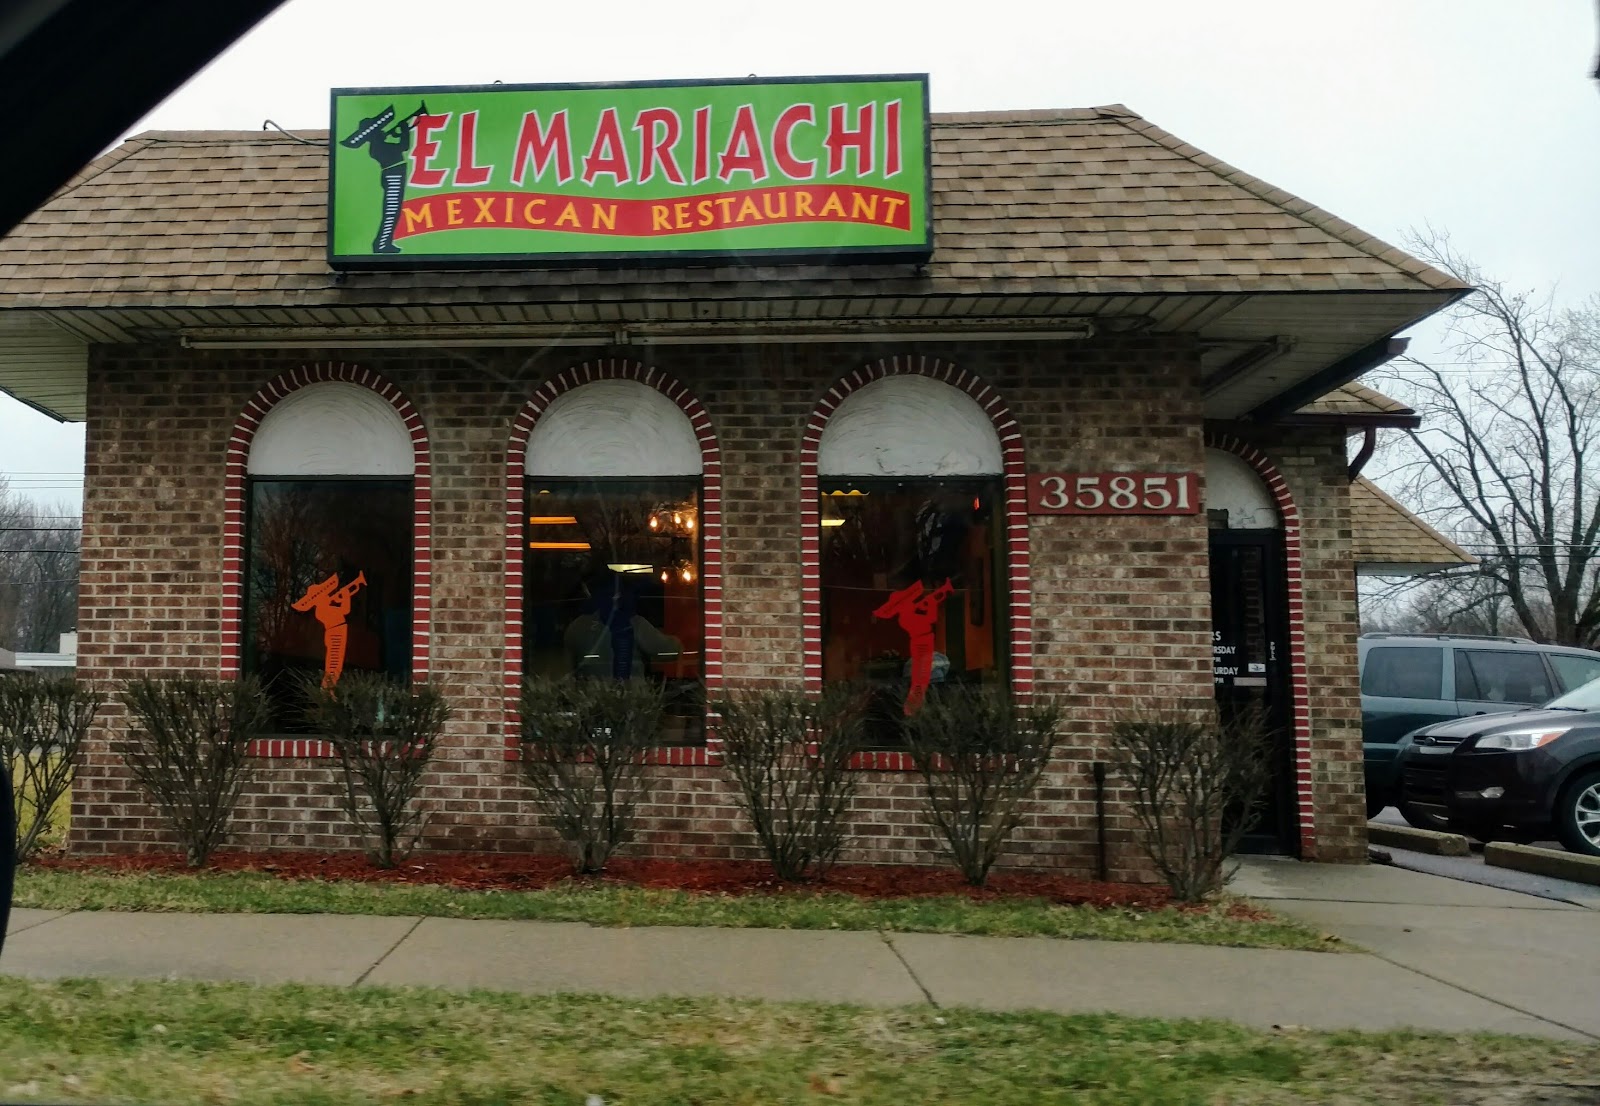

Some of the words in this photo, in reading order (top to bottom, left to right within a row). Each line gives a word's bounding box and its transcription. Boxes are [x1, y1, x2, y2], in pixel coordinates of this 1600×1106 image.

[407, 109, 495, 188] EL
[510, 98, 903, 187] MARIACHI
[402, 197, 617, 232] MEXICAN
[652, 191, 906, 231] RESTAURANT
[1039, 475, 1191, 509] 35851
